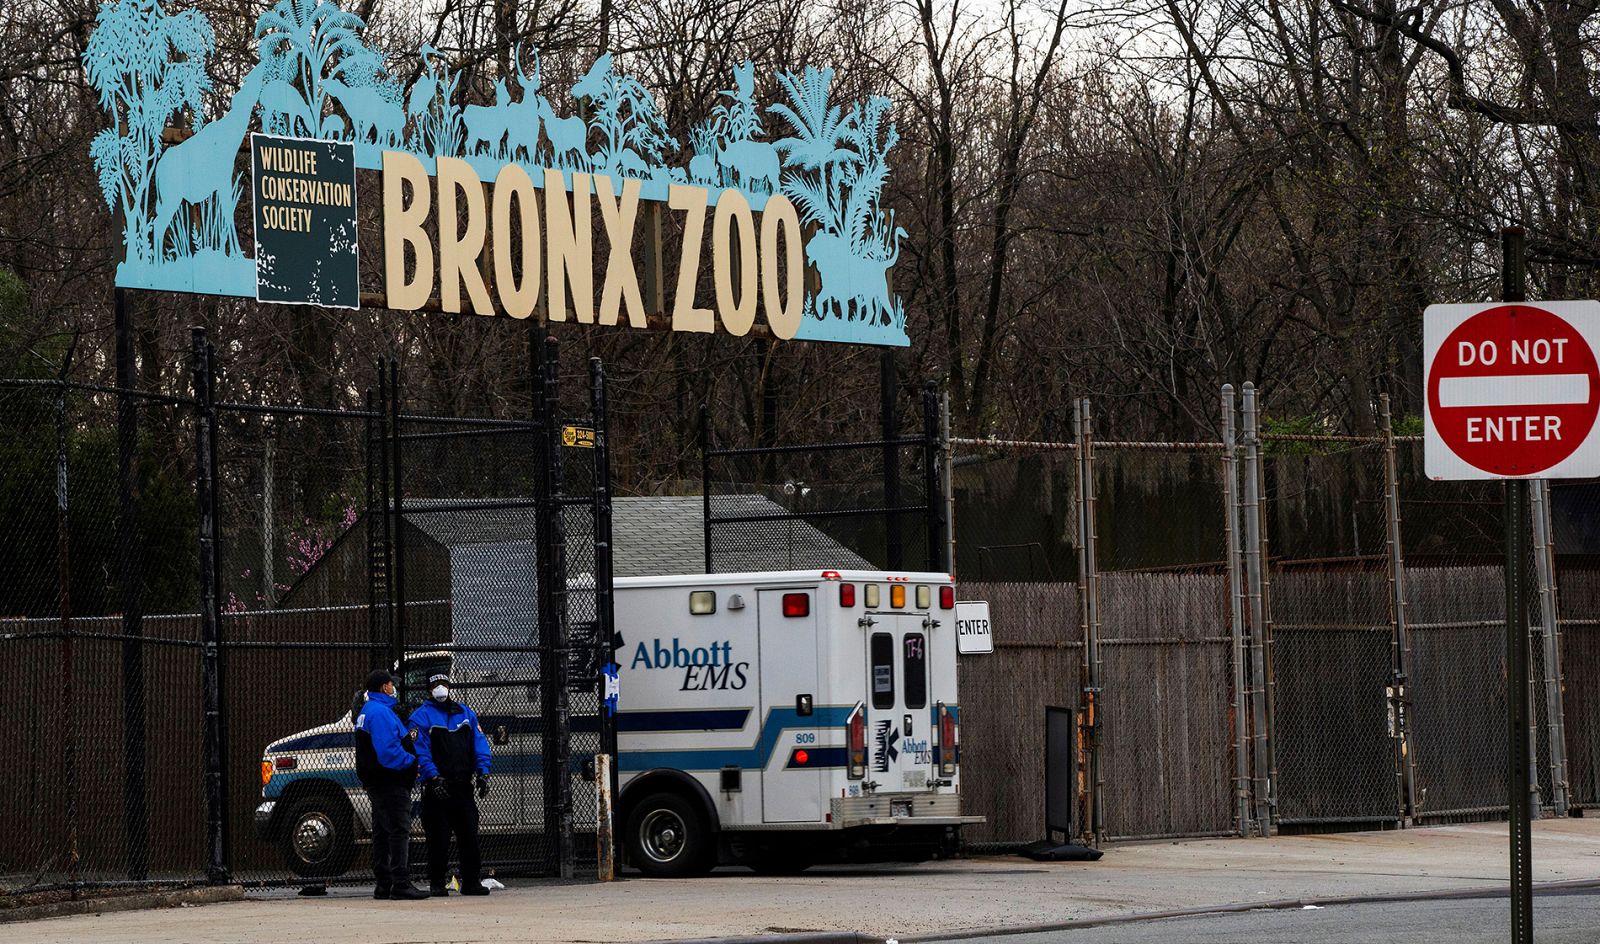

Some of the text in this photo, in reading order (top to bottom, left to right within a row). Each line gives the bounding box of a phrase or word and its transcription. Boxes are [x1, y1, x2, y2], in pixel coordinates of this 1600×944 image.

[260, 146, 317, 175] WILDLIFE
[262, 176, 351, 207] CONSERVATION
[262, 205, 312, 232] SOCIETY
[382, 151, 803, 340] BRONX ZOO
[1458, 338, 1568, 366] DO NOT
[1467, 416, 1562, 442] ENTER
[958, 619, 989, 635] ENTER
[631, 638, 732, 669] Abbott
[679, 662, 749, 691] EMS
[902, 738, 927, 753] Abbott
[914, 750, 931, 765] EMS
